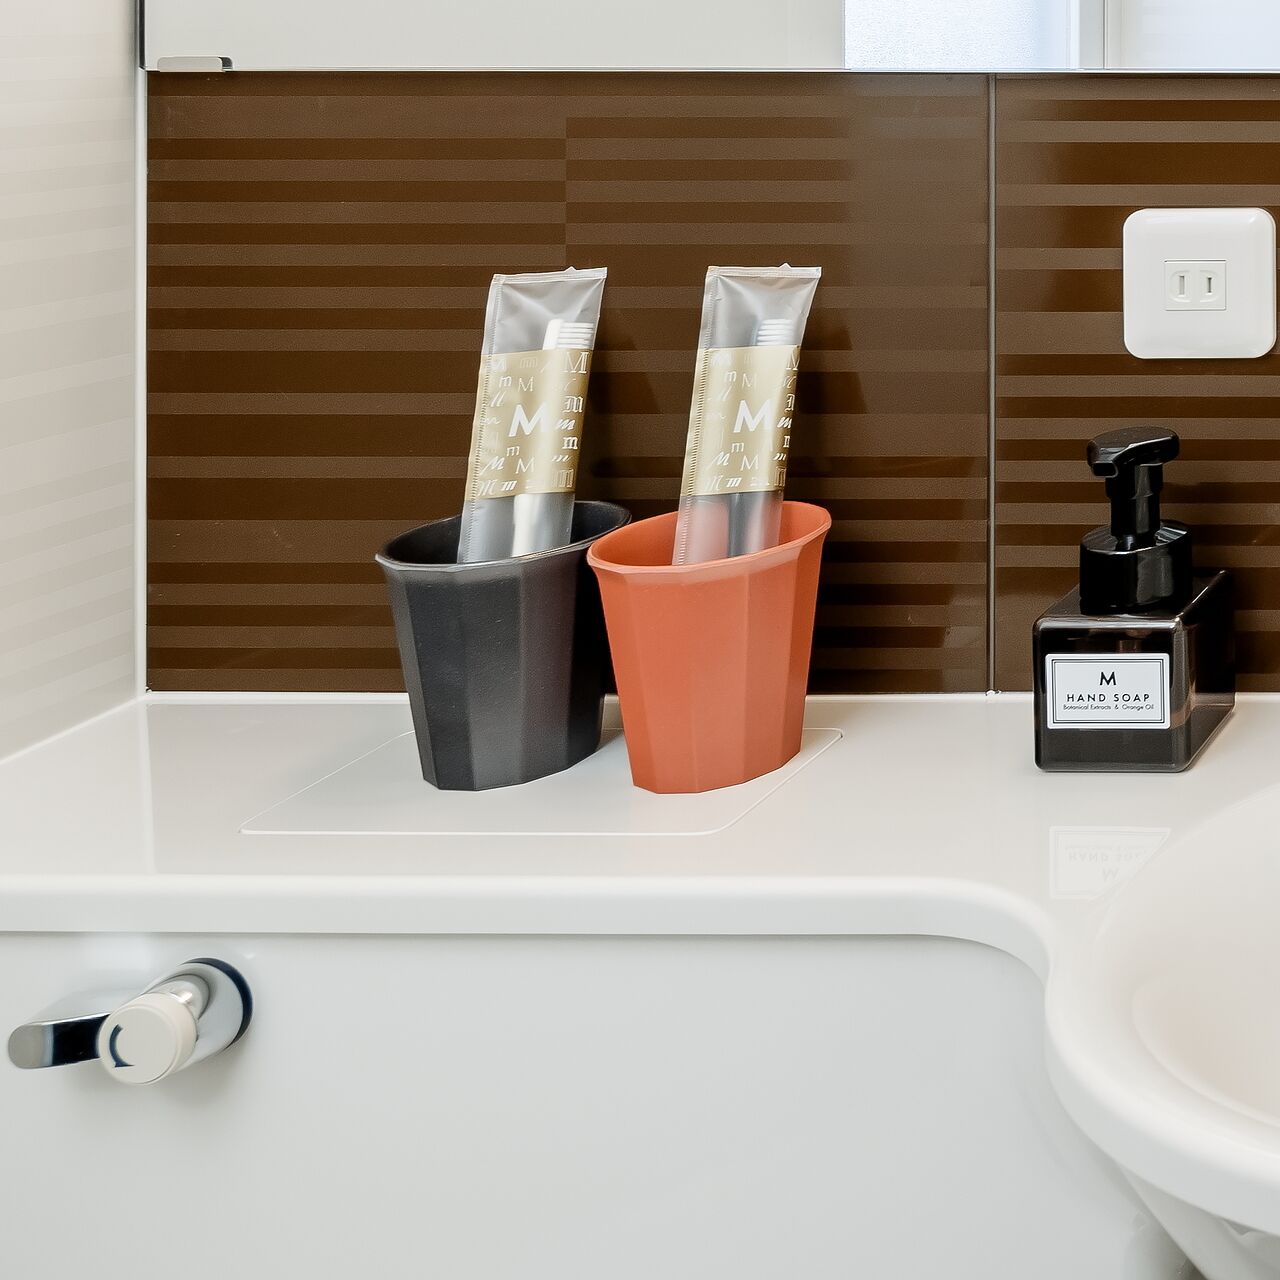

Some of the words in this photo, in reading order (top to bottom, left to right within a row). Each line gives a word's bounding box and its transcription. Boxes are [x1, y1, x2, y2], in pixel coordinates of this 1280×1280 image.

[508, 404, 548, 437] M
[733, 400, 772, 433] M
[1100, 671, 1116, 686] M
[1067, 694, 1106, 702] HAND
[1114, 694, 1150, 702] SOAP
